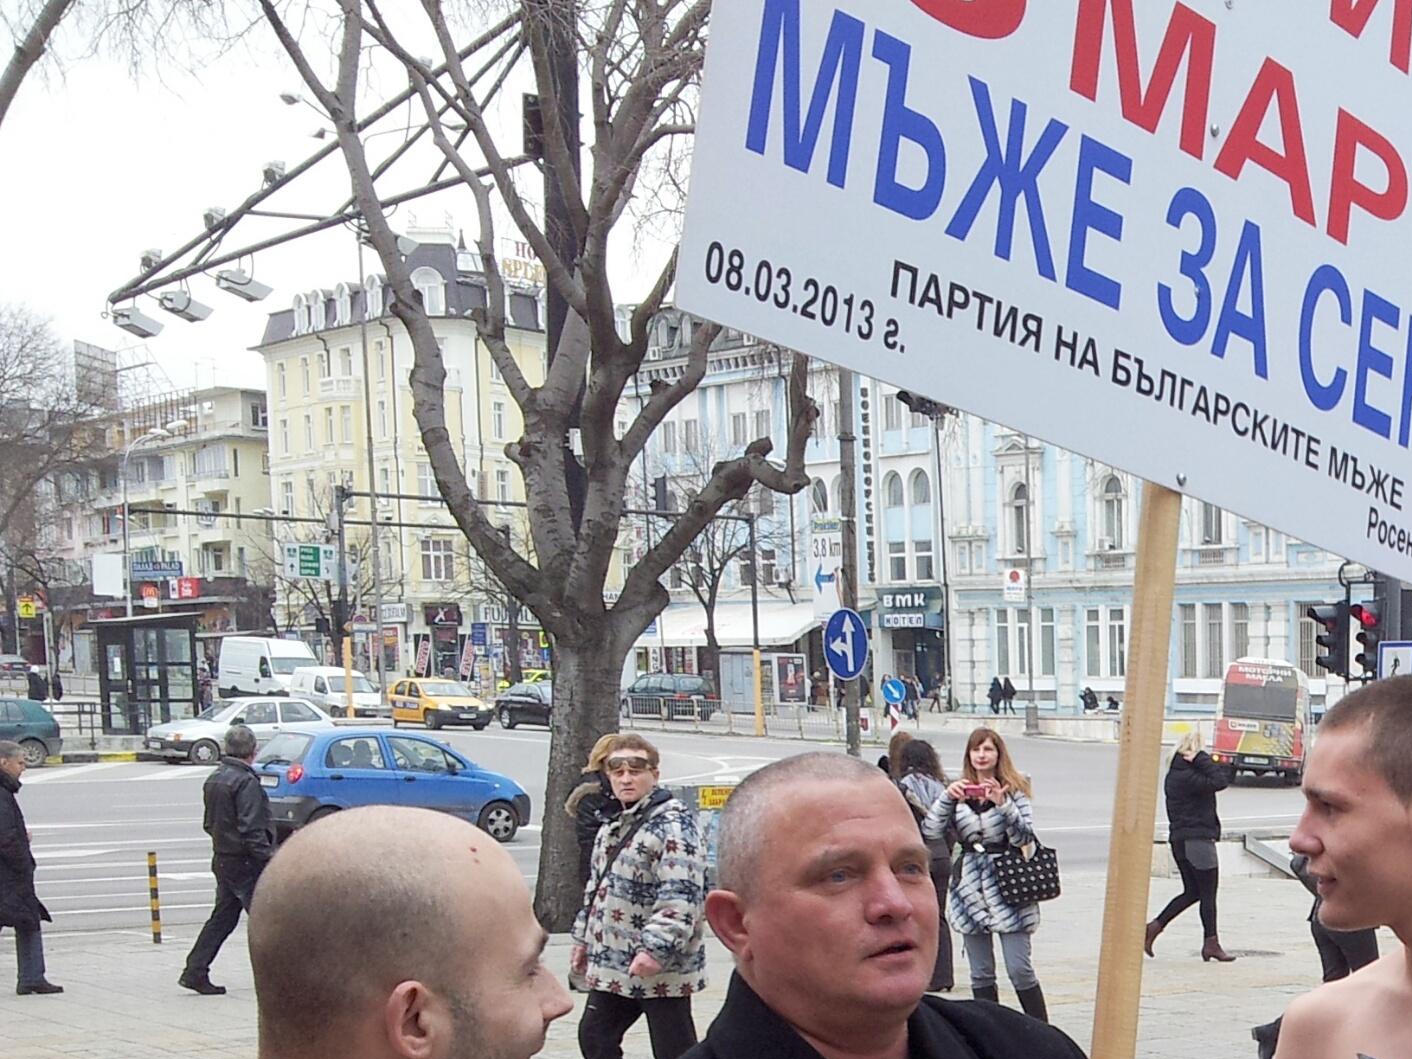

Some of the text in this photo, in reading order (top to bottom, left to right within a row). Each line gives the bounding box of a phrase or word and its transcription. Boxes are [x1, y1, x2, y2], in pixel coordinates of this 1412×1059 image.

[705, 240, 875, 341] 08.03.2013
[745, 0, 1133, 311] МЪЖЕ
[1157, 186, 1269, 381] ЗА
[890, 259, 1405, 511] ПАРТИЯ НА БЪЛГАРСКИТЕ МЪЖЕ
